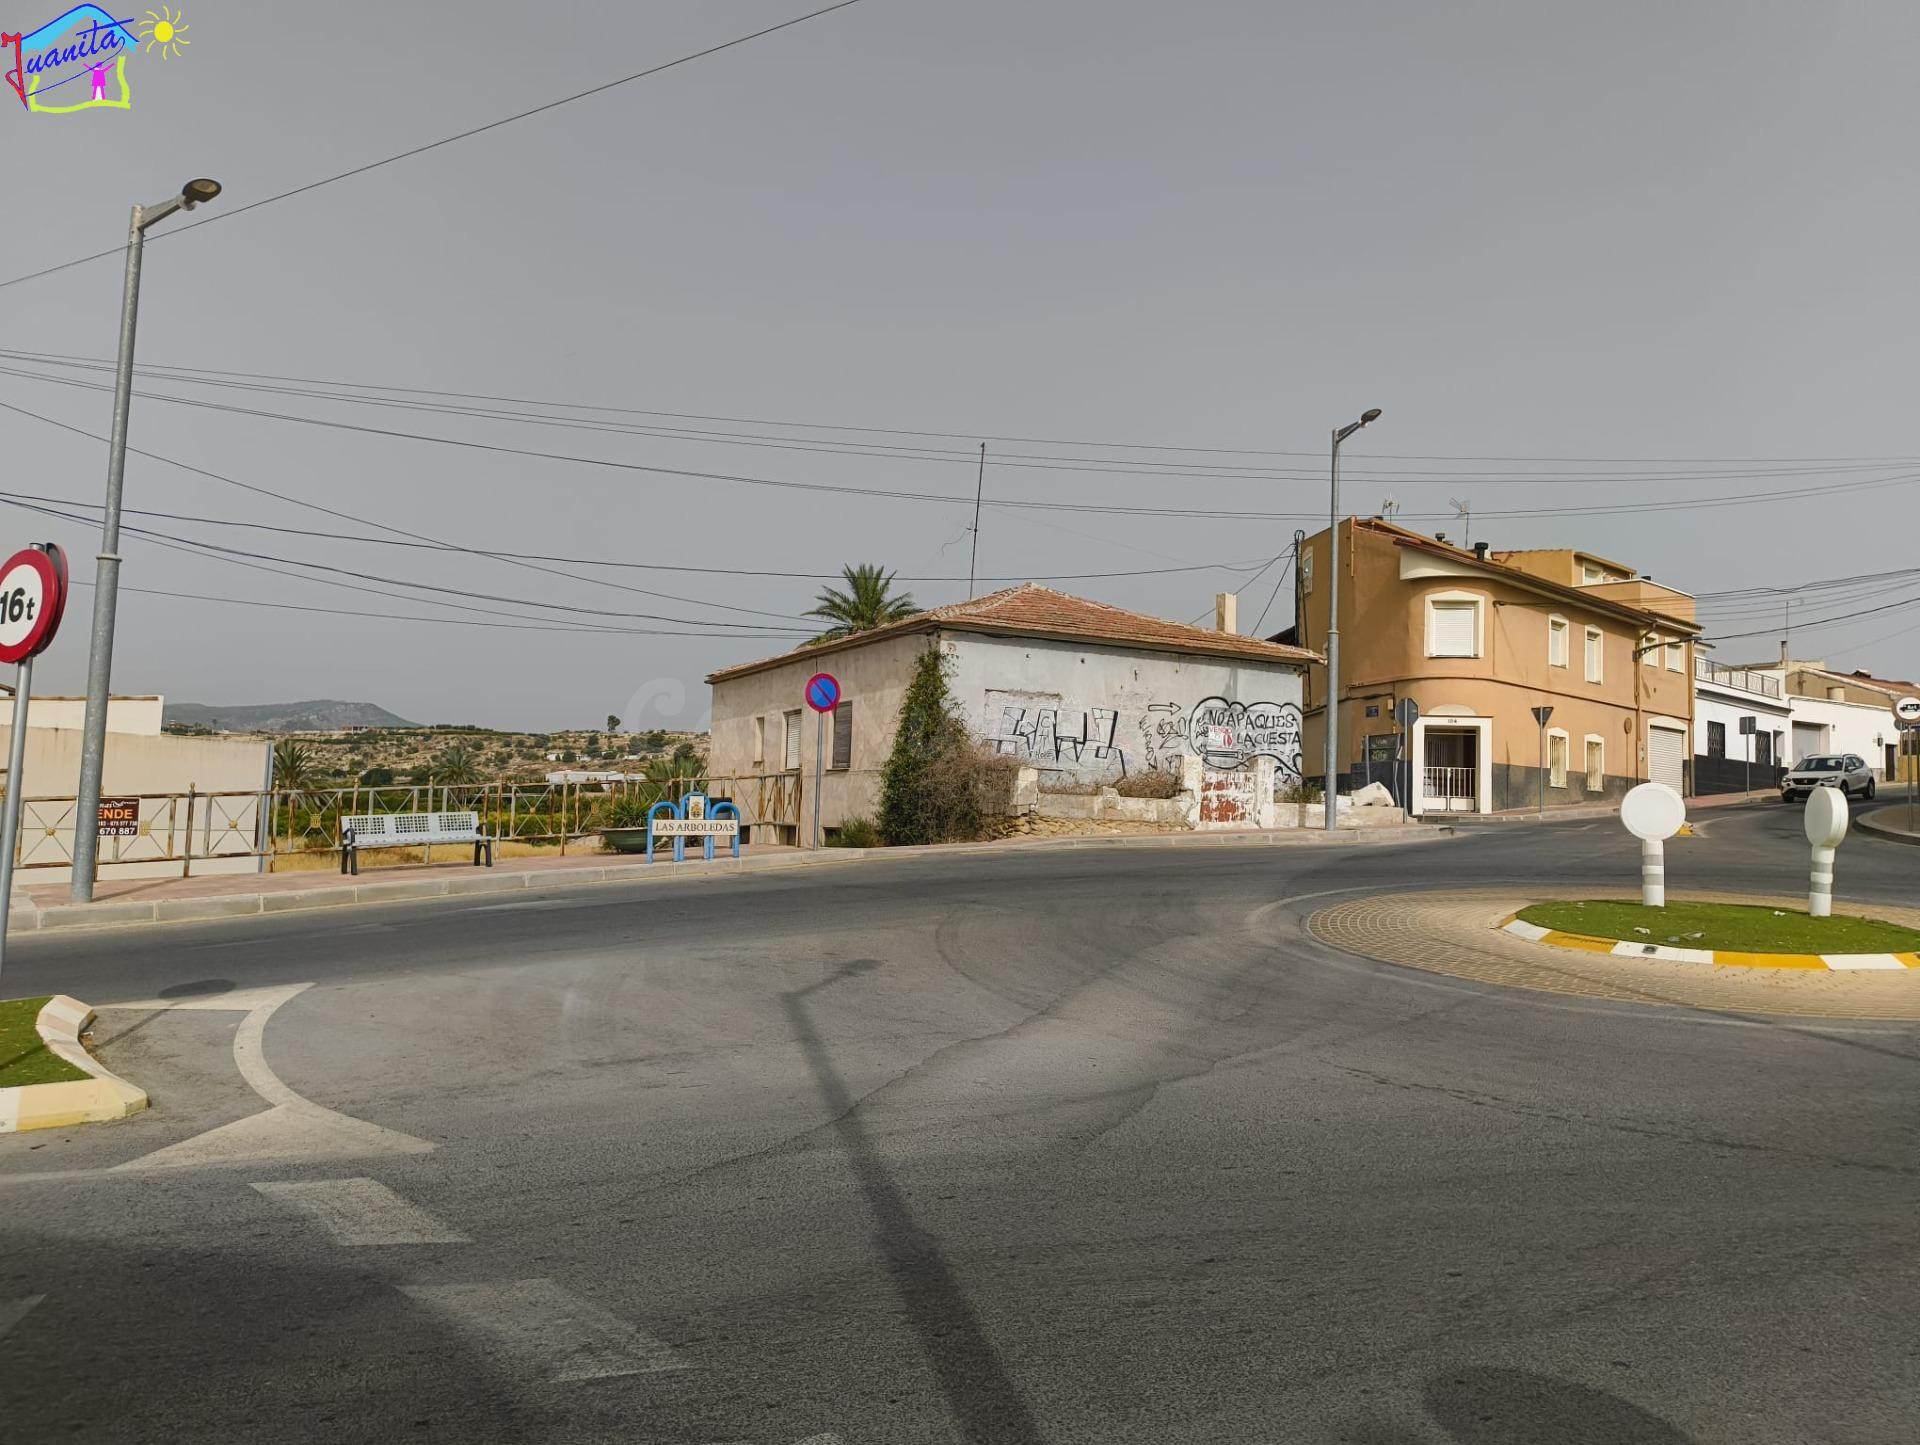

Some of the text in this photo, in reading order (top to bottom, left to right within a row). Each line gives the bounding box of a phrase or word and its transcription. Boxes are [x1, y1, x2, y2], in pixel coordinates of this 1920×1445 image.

[1208, 709, 1225, 727] NO
[1237, 731, 1301, 748] LA CUESTA
[98, 808, 133, 819] ENDE
[99, 827, 135, 835] 670 887
[655, 822, 735, 832] LAS ARBOLEDAS
